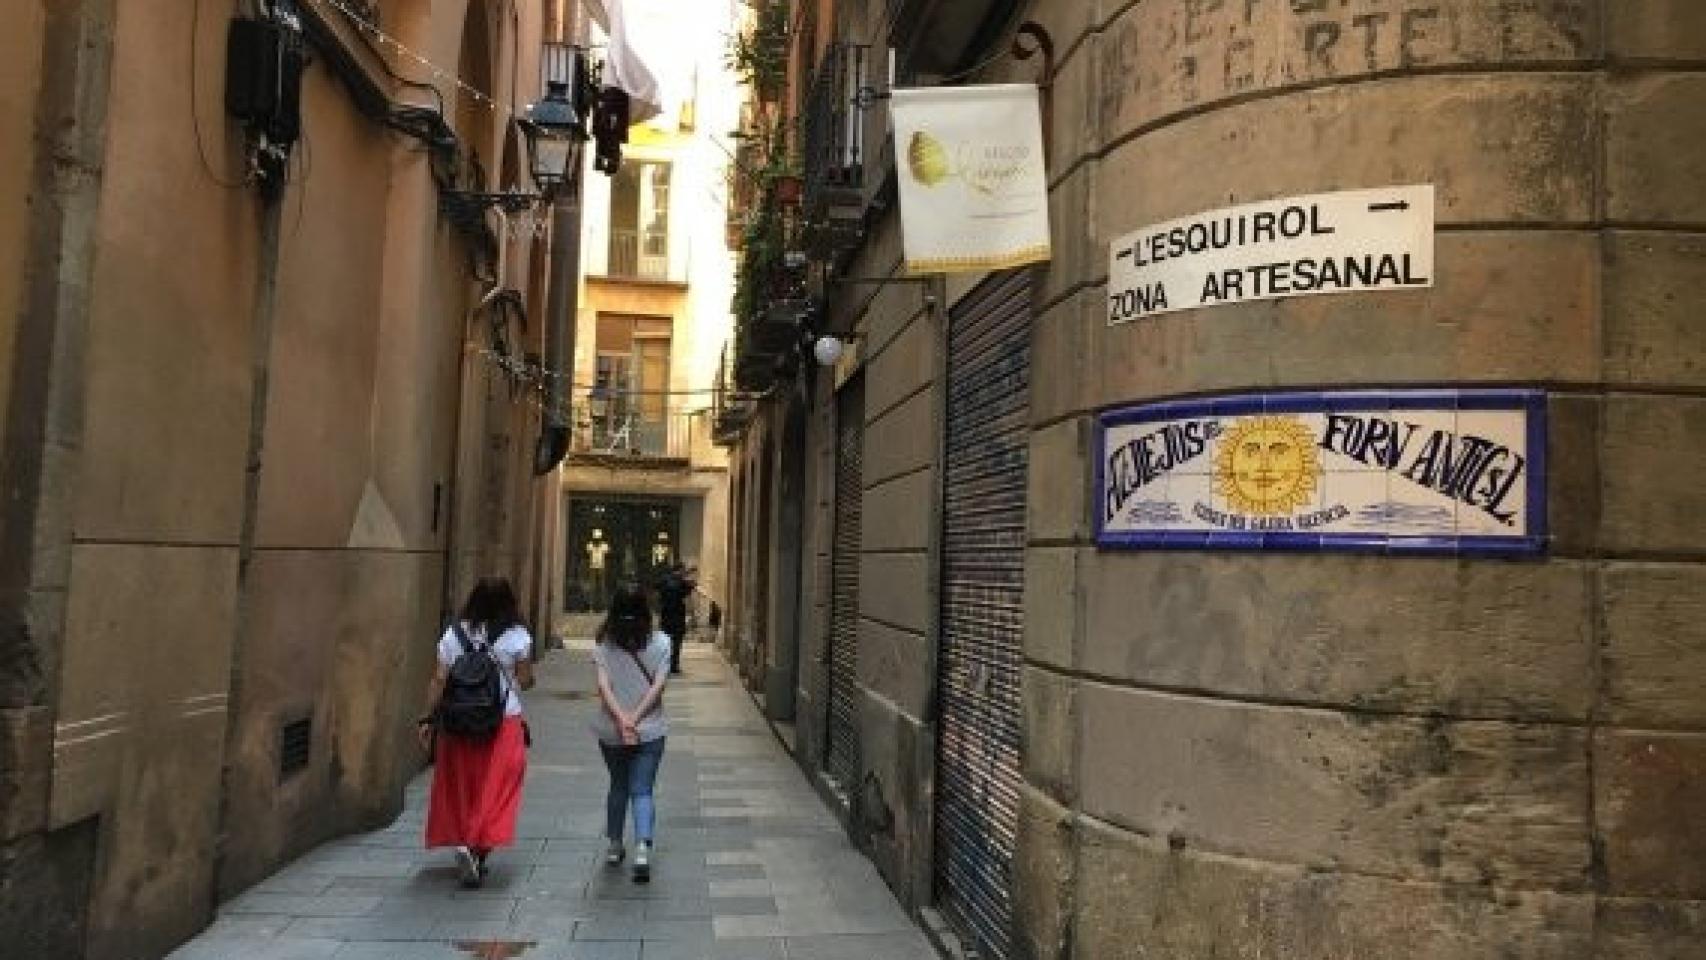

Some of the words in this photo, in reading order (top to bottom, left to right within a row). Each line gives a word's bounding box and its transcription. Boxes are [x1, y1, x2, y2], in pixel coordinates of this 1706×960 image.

[1109, 280, 1168, 321] ZONA
[1199, 252, 1429, 303] ARTESANAL
[1317, 414, 1423, 470] FORN
